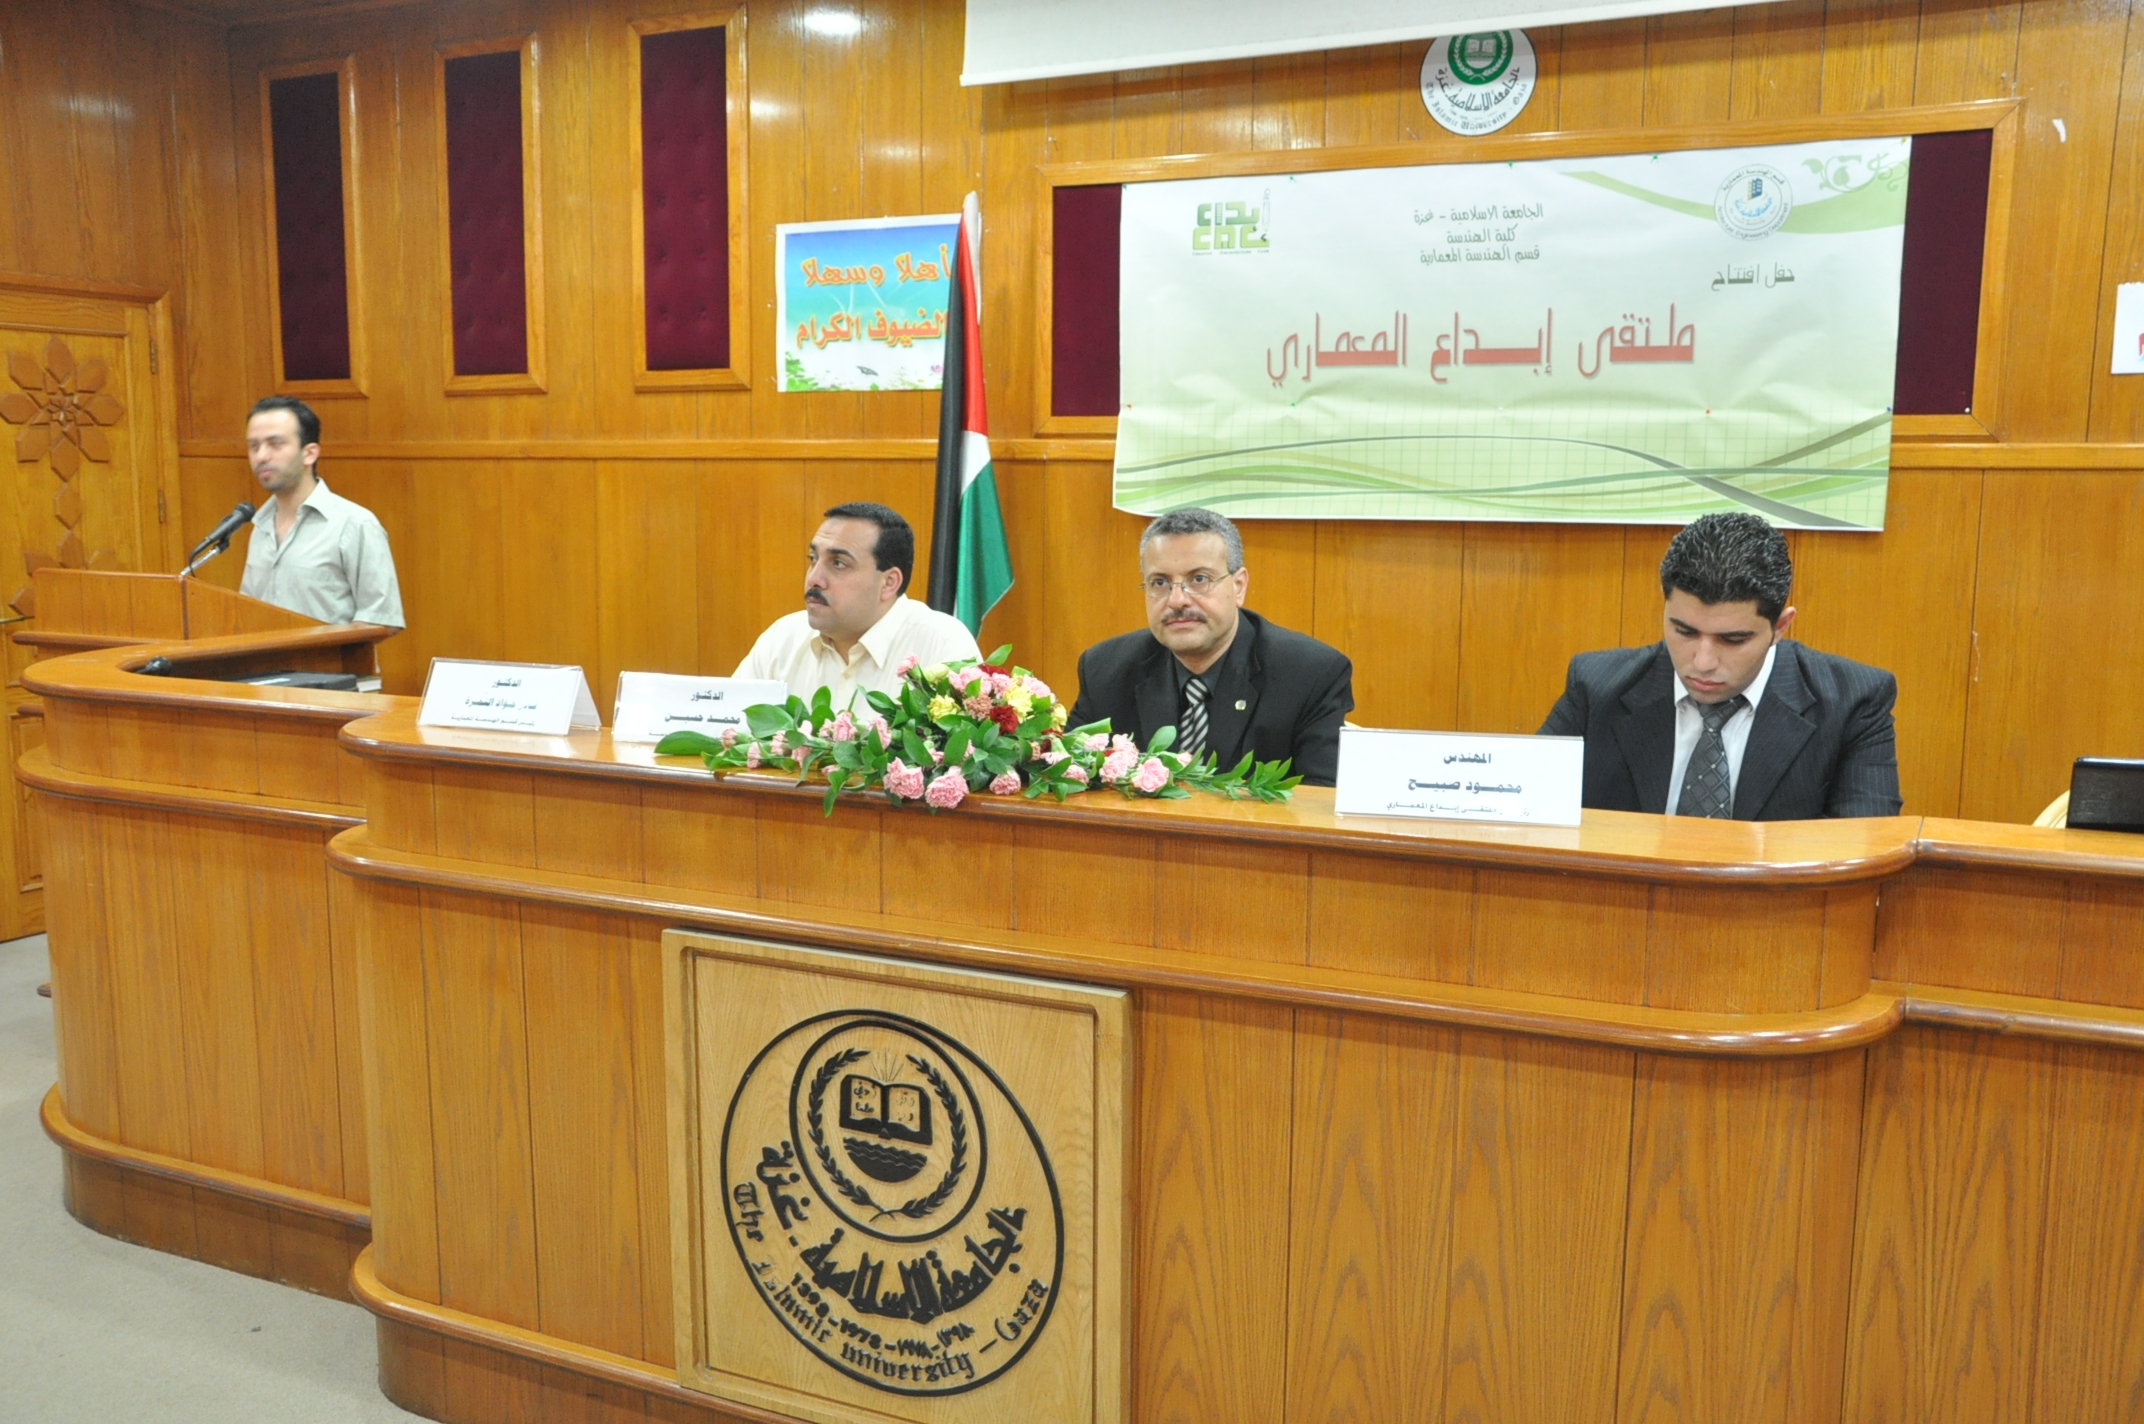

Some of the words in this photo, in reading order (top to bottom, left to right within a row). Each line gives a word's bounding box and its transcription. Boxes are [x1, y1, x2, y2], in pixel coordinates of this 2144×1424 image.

[1425, 81, 1435, 100] The
[1414, 209, 1434, 225] غزة
[1451, 205, 1499, 225] الاسلامية
[1502, 202, 1544, 221] الجامعة
[1447, 228, 1491, 244] الهندسة
[1495, 223, 1519, 243] كلية
[1420, 247, 1462, 266] المعمارية
[1465, 243, 1511, 261] الهندسة
[1514, 244, 1540, 263] قسم
[801, 256, 885, 287] وسهلا
[894, 242, 952, 283] أهلا
[1711, 263, 1760, 291] افتتاح
[1764, 262, 1795, 288] حفل
[796, 312, 861, 349] الكرام
[1267, 310, 1408, 388] المعماري
[1430, 307, 1553, 383] إبداع
[1577, 302, 1696, 379] ملتقى
[491, 677, 522, 688] الدكتور
[690, 690, 724, 702] الدكتور
[664, 712, 704, 724] حسين
[707, 715, 741, 725] محمد
[1443, 752, 1492, 765] المهندس
[1407, 777, 1461, 793] صبيح
[1465, 780, 1522, 795] محمود
[1386, 796, 1428, 810] المعماري
[1429, 799, 1460, 813] إبداع
[756, 1140, 810, 1230] غزة
[733, 1181, 764, 1242] The
[752, 1256, 834, 1344] Islamic
[994, 1278, 1049, 1341] Gaza
